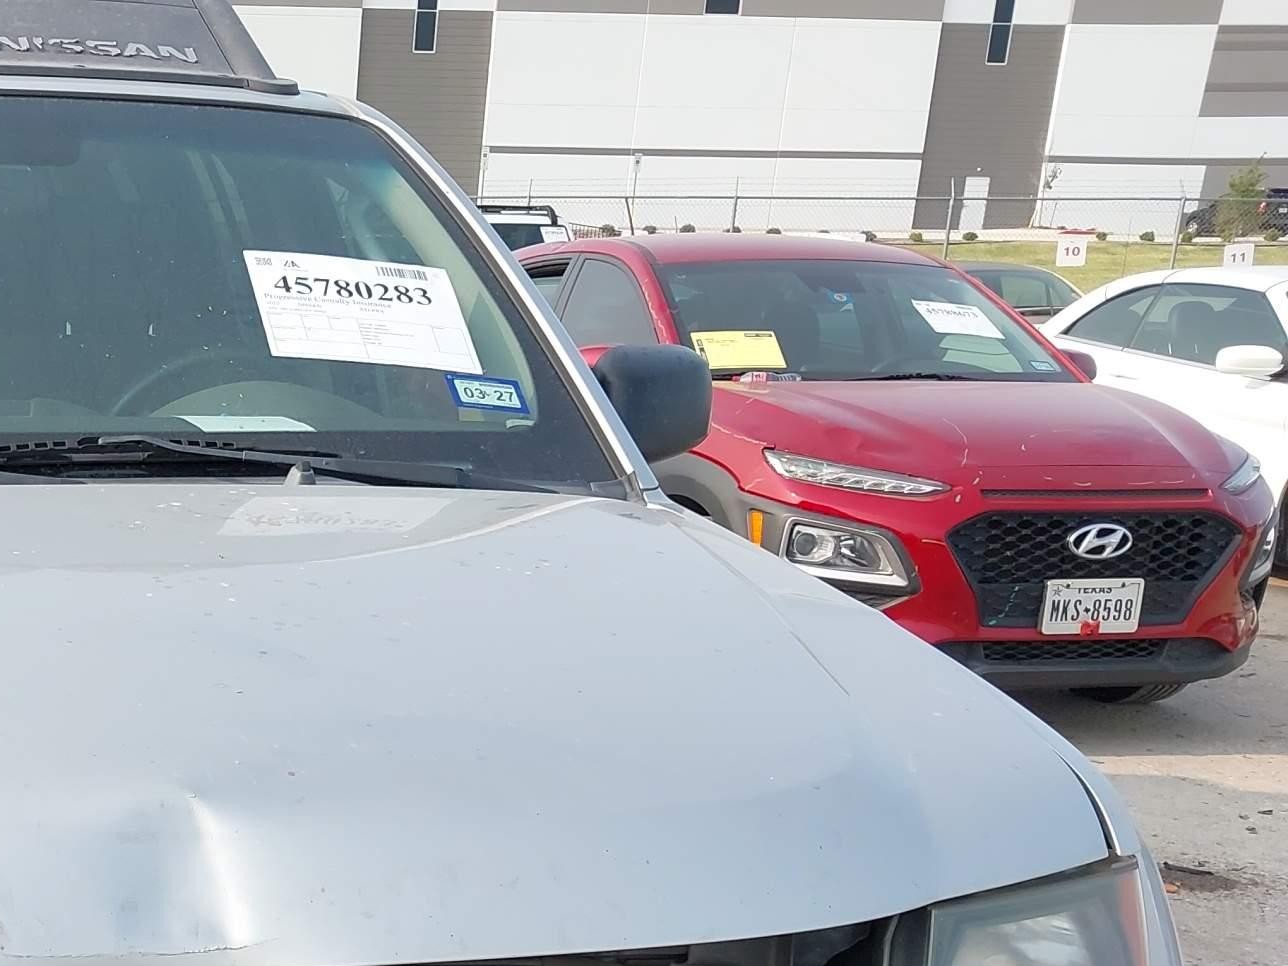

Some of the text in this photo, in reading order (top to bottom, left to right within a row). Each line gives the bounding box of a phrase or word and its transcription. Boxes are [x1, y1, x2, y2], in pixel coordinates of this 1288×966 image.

[1063, 246, 1081, 257] 10
[1230, 252, 1247, 263] 11
[273, 275, 433, 306] 45780283
[463, 386, 514, 403] 03 27
[1077, 587, 1113, 595] TEXAS
